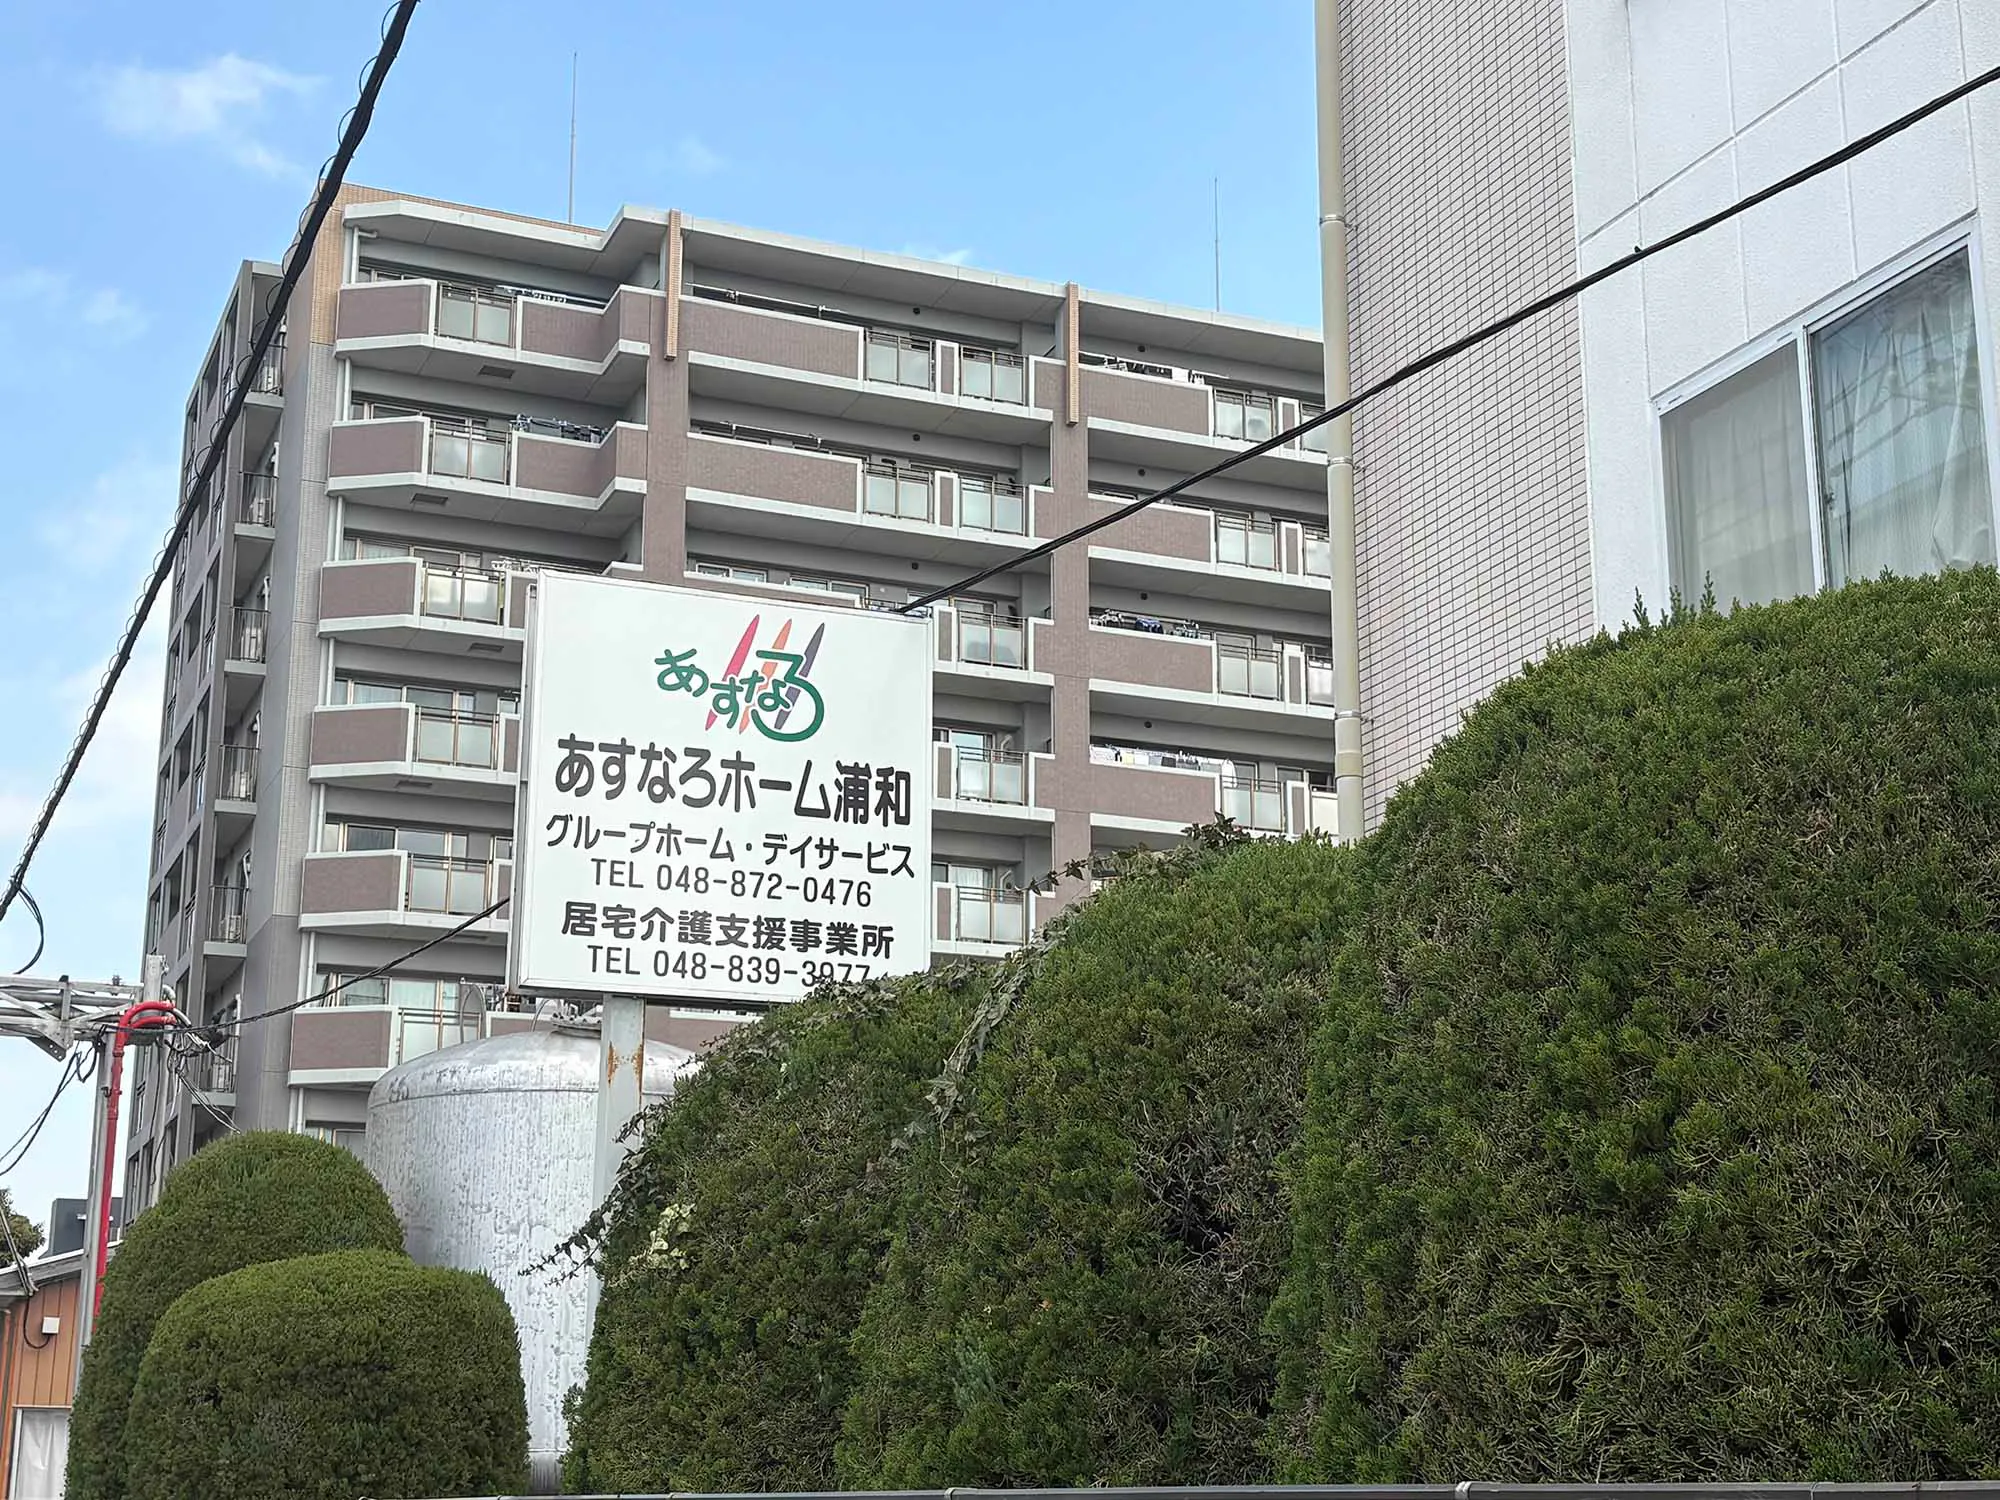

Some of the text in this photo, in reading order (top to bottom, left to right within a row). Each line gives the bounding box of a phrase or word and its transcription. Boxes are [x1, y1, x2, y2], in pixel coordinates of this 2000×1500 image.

[654, 648, 826, 743] あすなろ
[555, 732, 911, 828] あすなろホーム浦和
[590, 857, 872, 908] TEL 048-872-0476
[561, 900, 895, 960] 居宅介護支援事業所
[587, 944, 641, 975] TEL
